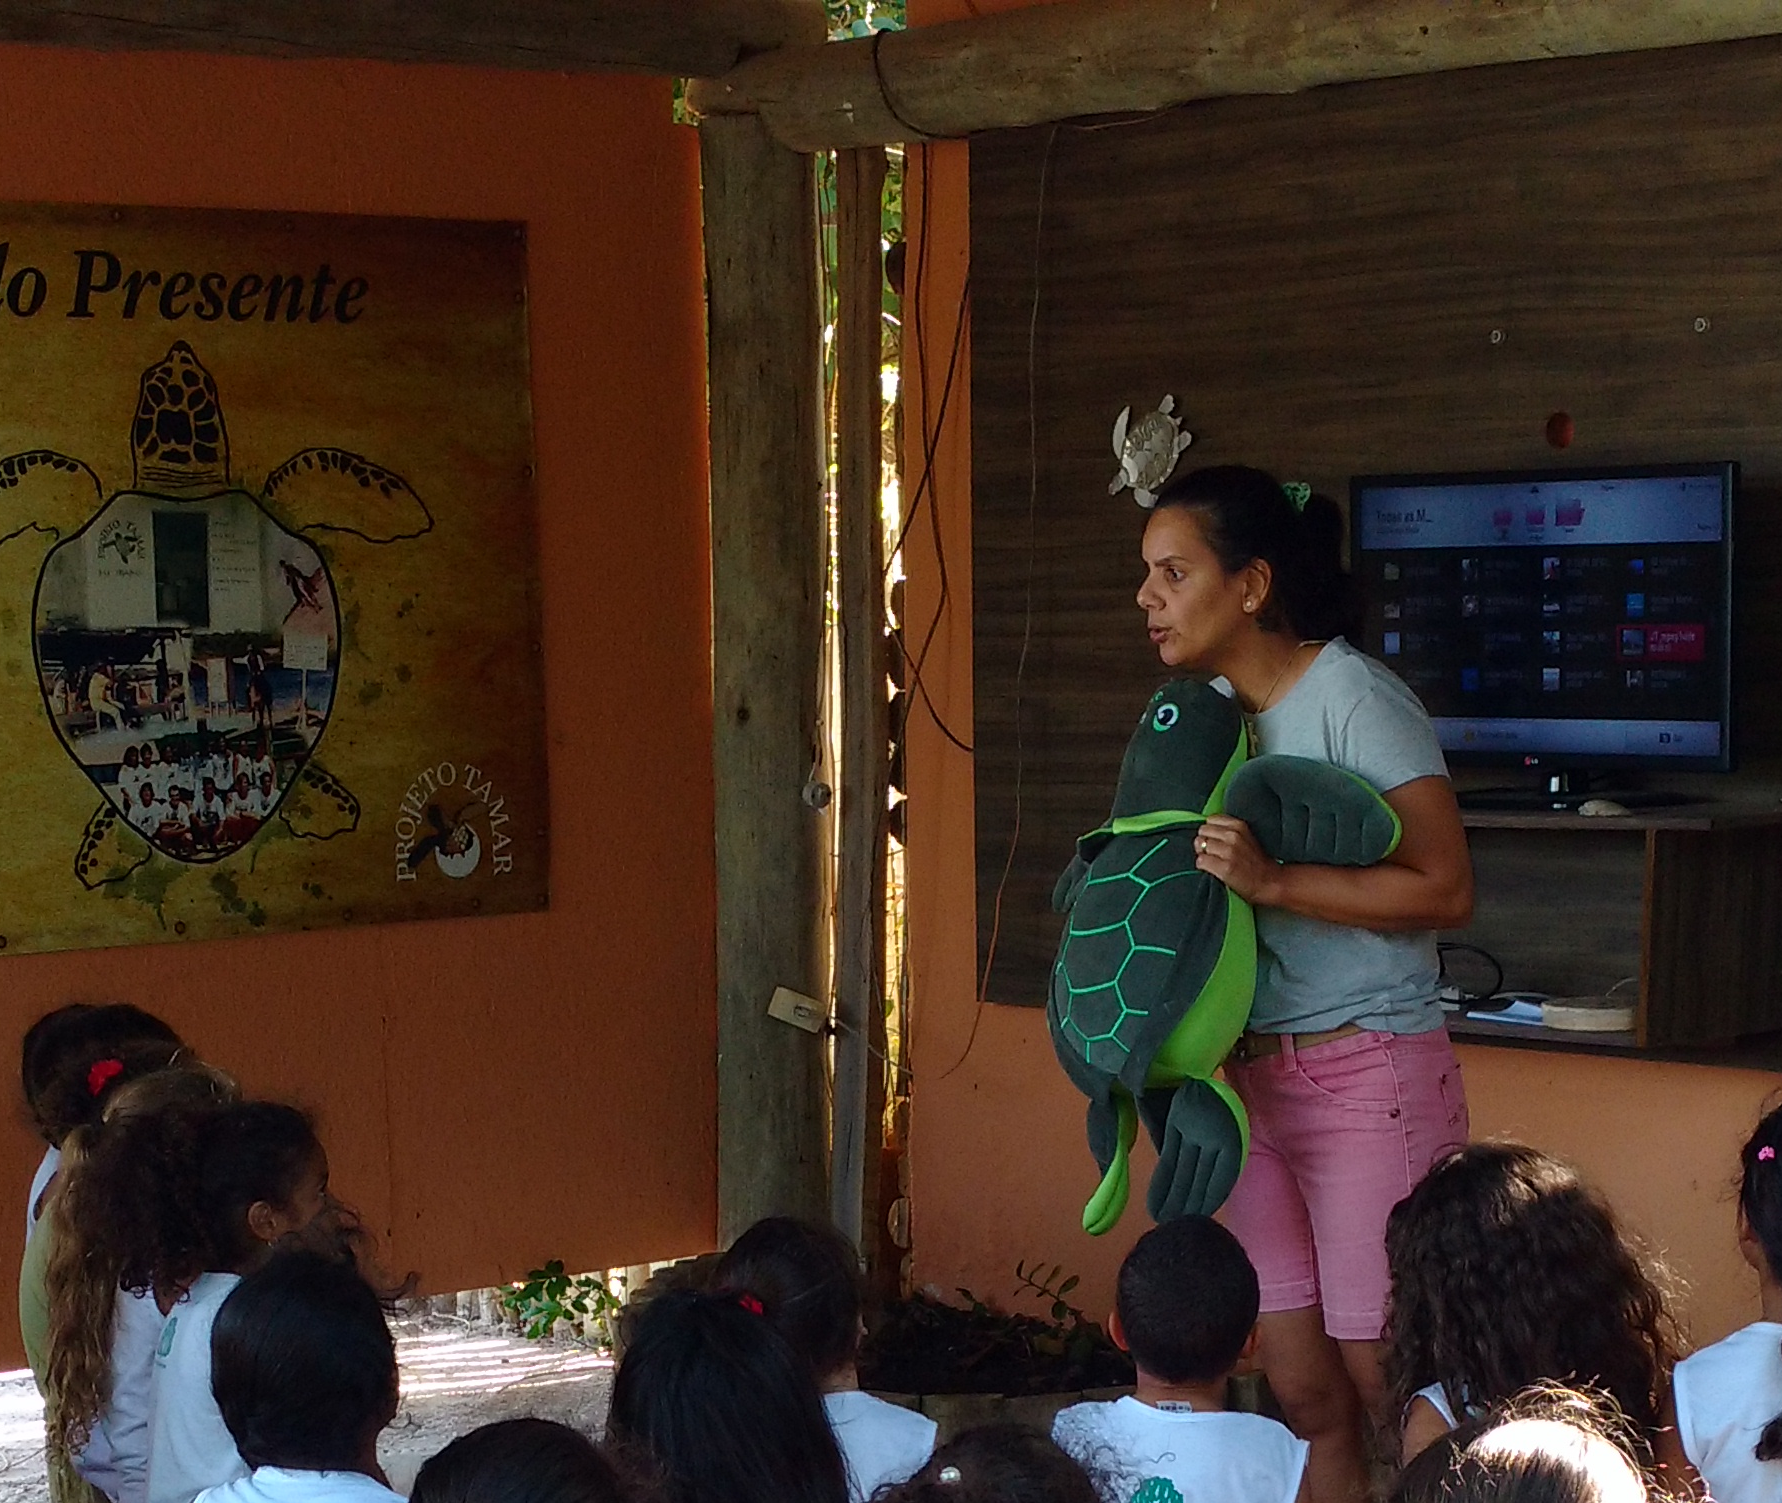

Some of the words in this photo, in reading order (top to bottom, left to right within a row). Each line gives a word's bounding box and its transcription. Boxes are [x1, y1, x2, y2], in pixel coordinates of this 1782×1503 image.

[67, 248, 369, 324] Presente
[395, 762, 457, 882] PROJETO
[462, 764, 514, 876] TAMAR
